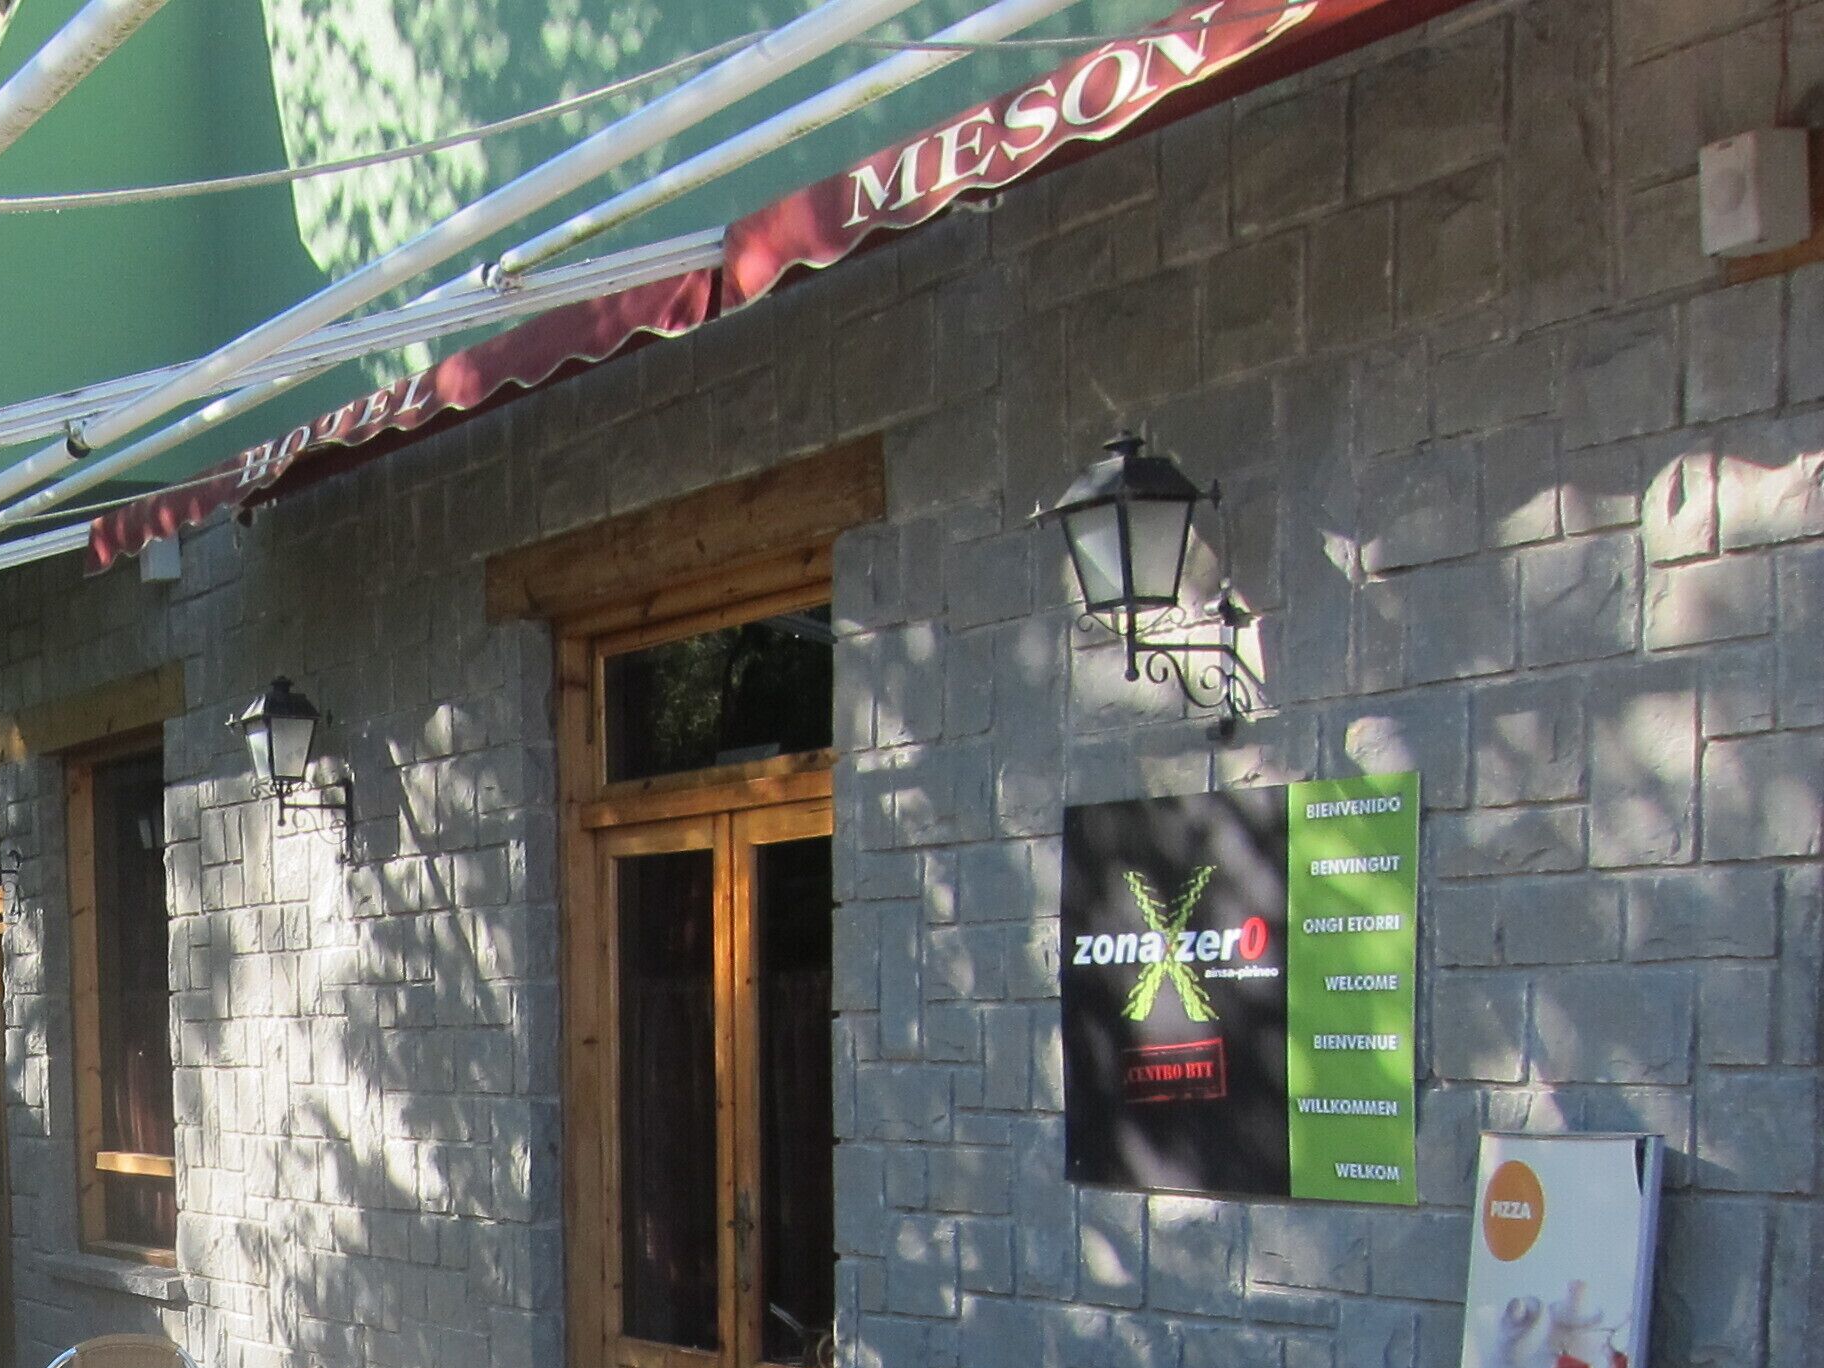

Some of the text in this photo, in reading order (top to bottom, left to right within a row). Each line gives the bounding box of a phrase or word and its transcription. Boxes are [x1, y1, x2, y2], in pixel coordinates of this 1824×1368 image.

[237, 371, 433, 488] HOTEL
[1306, 796, 1401, 819] BIENVENIDO
[1310, 856, 1400, 876] BENVINGUT
[1303, 914, 1400, 934] ONGI ETORRI
[1073, 930, 1164, 965] zona
[1324, 974, 1398, 991] WELCOME
[1313, 1034, 1398, 1050] BIENVENUE
[1127, 1064, 1182, 1081] CENTRO
[1297, 1098, 1398, 1117] WILLKOMMEN
[1335, 1162, 1400, 1181] WELKOM
[1490, 1200, 1532, 1220] PIZZA
